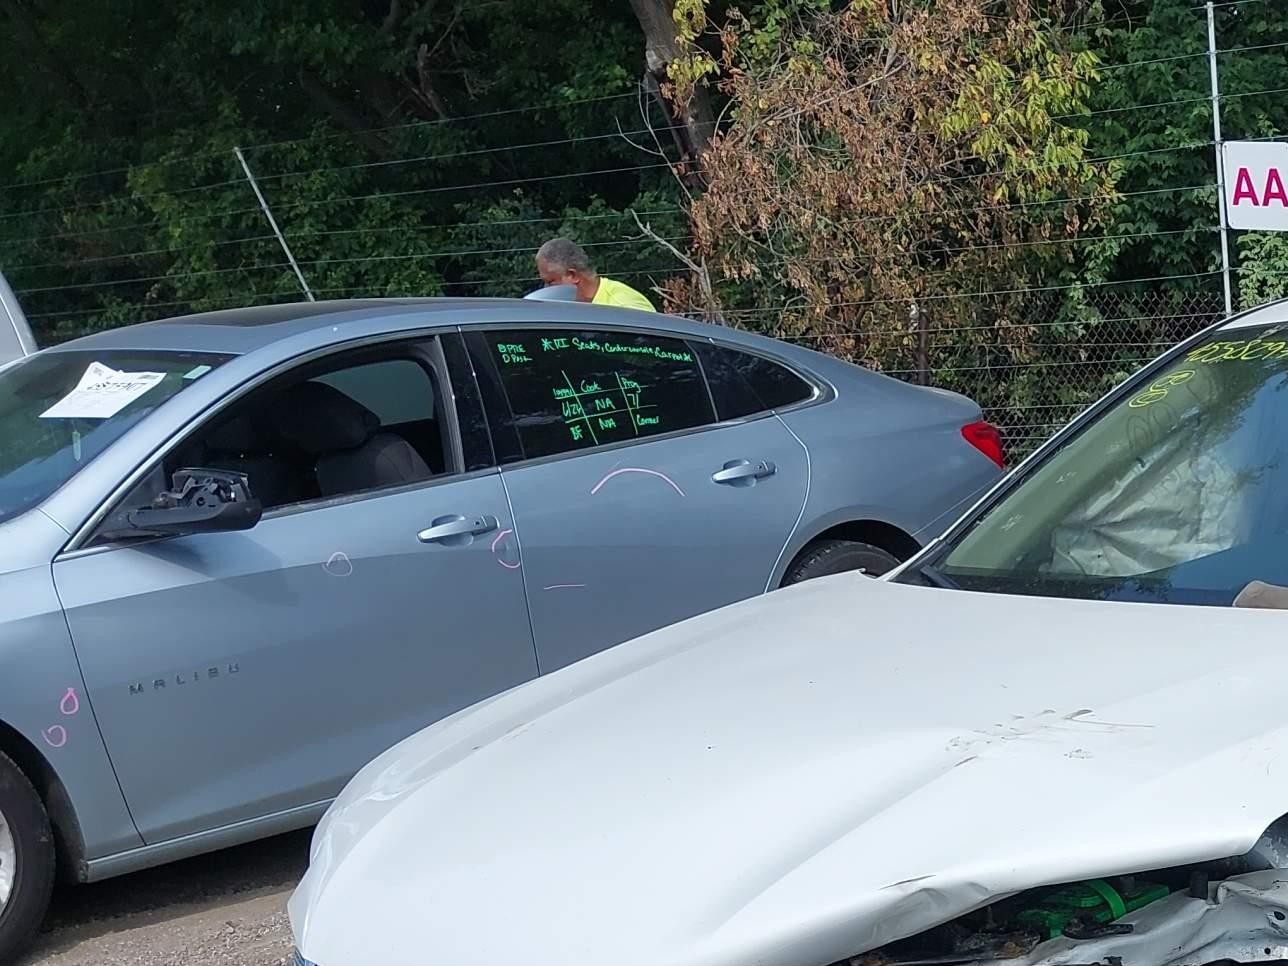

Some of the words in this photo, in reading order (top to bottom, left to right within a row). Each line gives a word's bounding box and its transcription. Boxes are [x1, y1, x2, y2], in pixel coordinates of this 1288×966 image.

[595, 397, 616, 411] NA
[598, 418, 617, 431] NA
[129, 663, 240, 696] MALIBU
